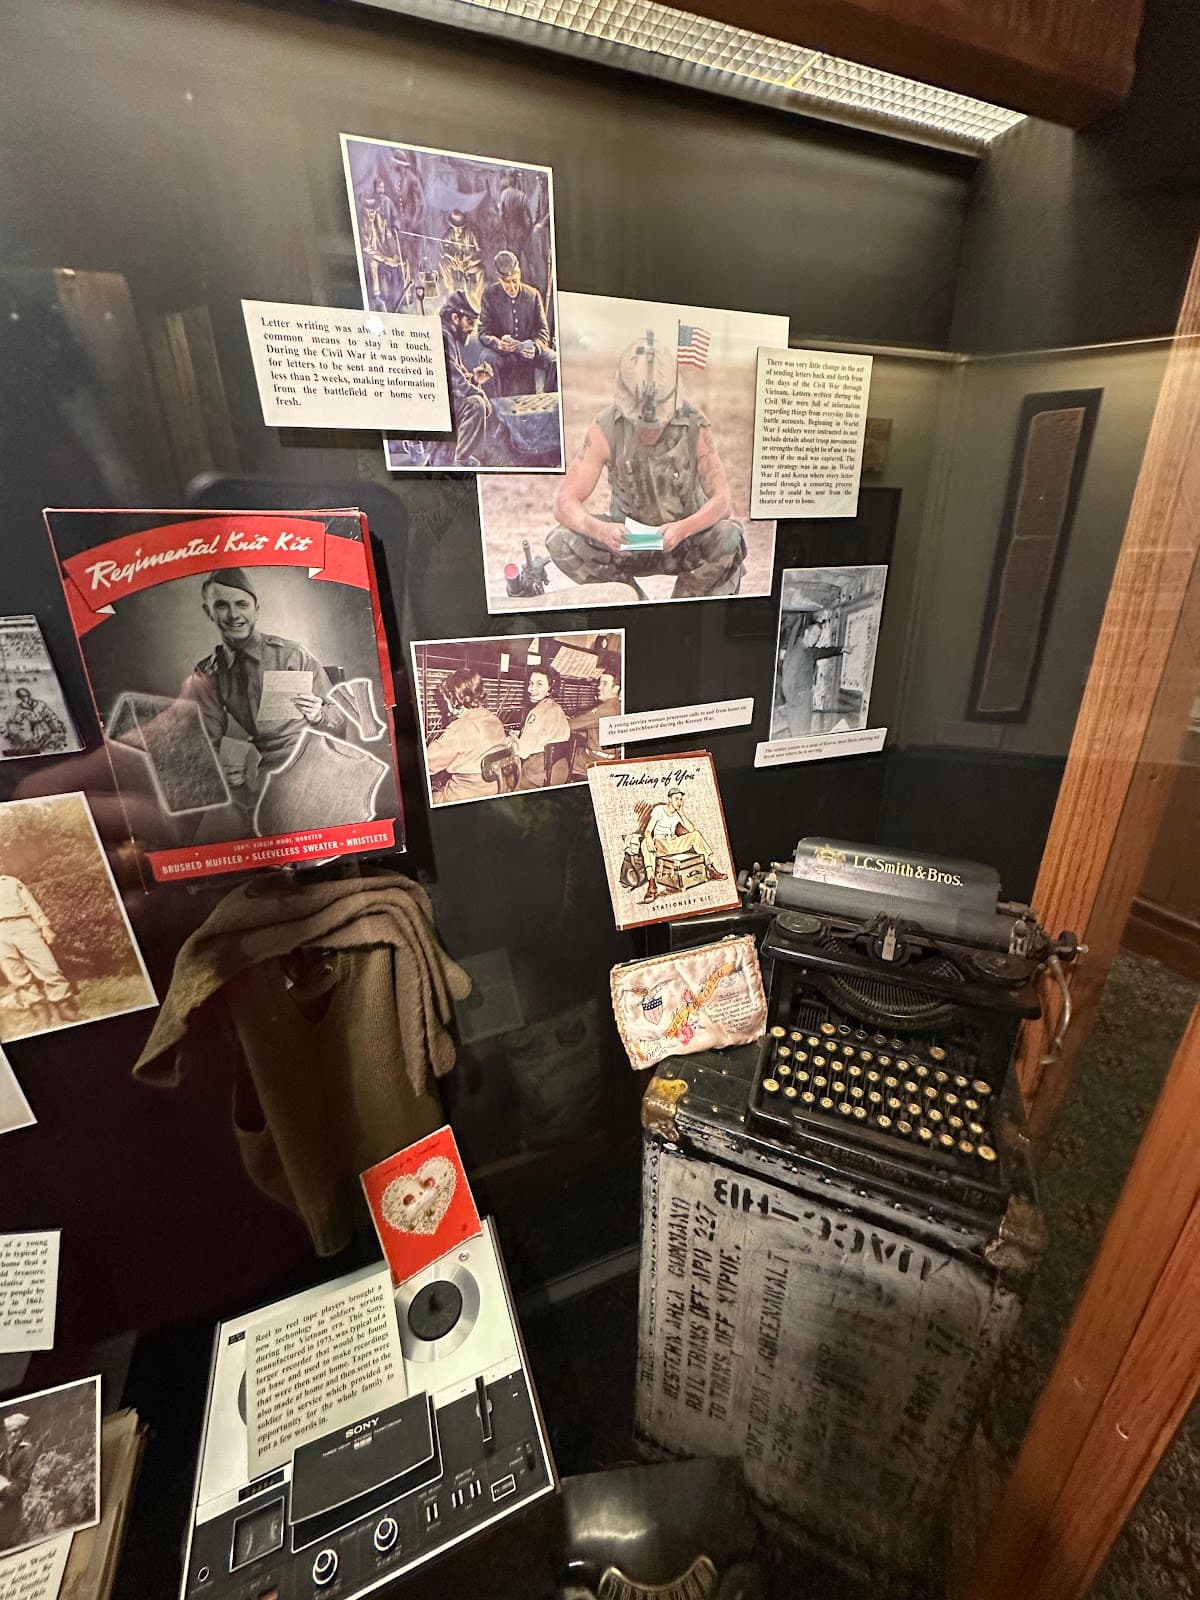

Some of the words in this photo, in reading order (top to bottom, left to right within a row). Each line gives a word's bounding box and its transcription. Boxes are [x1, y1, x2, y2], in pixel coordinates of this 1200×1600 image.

[261, 317, 290, 328] Letter
[296, 321, 330, 333] writing
[334, 324, 352, 334] was
[392, 328, 405, 337] the
[410, 331, 430, 339] most
[264, 333, 303, 342] common
[312, 337, 340, 345] means
[348, 338, 357, 346] to
[365, 340, 381, 350] stay
[390, 340, 399, 349] in
[406, 342, 432, 351] touch.
[266, 344, 300, 357] During
[303, 347, 318, 356] the
[321, 348, 343, 358] Civil
[347, 350, 366, 359] War
[371, 352, 377, 360] it
[400, 355, 433, 364] possible
[268, 357, 282, 367] for
[286, 359, 315, 369] letters
[319, 362, 328, 370] to
[332, 362, 343, 371] be
[368, 365, 384, 373] and
[388, 366, 422, 375] received
[426, 367, 434, 376] in
[271, 371, 288, 380] less
[290, 372, 311, 381] than
[313, 373, 319, 382] 2
[322, 374, 351, 384] weeks,
[353, 376, 385, 386] making
[387, 378, 435, 388] information
[273, 384, 296, 393] from
[303, 385, 317, 394] the
[324, 386, 367, 397] battlefield
[390, 390, 412, 399] home
[419, 393, 436, 402] very
[276, 396, 302, 407] fresh.
[85, 534, 219, 591] Regimental
[223, 532, 270, 553] Knit
[273, 532, 313, 552] Kit
[660, 771, 671, 787] of
[161, 861, 202, 875] BRUSHED
[205, 854, 243, 869] MUFFLER
[252, 845, 300, 861] SLEEVELESS
[302, 840, 338, 855] SWEATER
[346, 832, 388, 847] WRISTLETS
[275, 837, 293, 846] WOOL
[667, 1197, 692, 1279] COMMAND
[691, 1247, 713, 1285] APO
[256, 1330, 271, 1343] Reel
[286, 1318, 299, 1330] reel
[303, 1312, 318, 1323] tape
[321, 1301, 345, 1317] players
[349, 1288, 374, 1303] brought
[665, 1289, 685, 1330] AREA
[688, 1284, 711, 1320] OFF
[256, 1344, 269, 1353] new
[276, 1326, 312, 1345] technology
[330, 1307, 355, 1321] soldiers
[360, 1294, 384, 1308] serving
[256, 1349, 280, 1364] during
[284, 1342, 295, 1352] the
[299, 1328, 328, 1344] Vietnam
[349, 1312, 363, 1323] This
[714, 1311, 736, 1348] OFF
[256, 1346, 306, 1374] manufactured
[307, 1344, 314, 1352] in
[336, 1330, 349, 1339] was
[350, 1317, 372, 1334] typical
[373, 1313, 380, 1322] of
[257, 1370, 279, 1386] larger
[282, 1355, 312, 1374] recorder
[316, 1347, 330, 1359] that
[333, 1336, 354, 1350] would
[357, 1332, 365, 1340] be
[368, 1321, 387, 1335] found
[687, 1320, 710, 1370] TRANS
[256, 1387, 266, 1396] on
[269, 1379, 285, 1391] base
[288, 1370, 302, 1382] and
[304, 1361, 320, 1375] used
[333, 1349, 351, 1361] make
[354, 1333, 389, 1352] recordings
[257, 1395, 272, 1407] that
[275, 1387, 292, 1399] were
[294, 1378, 310, 1390] then
[312, 1370, 327, 1381] sent
[352, 1351, 372, 1364] Tapes
[374, 1343, 389, 1353] were
[709, 1352, 732, 1401] TRANS
[257, 1408, 272, 1419] also
[274, 1397, 294, 1411] made
[295, 1392, 303, 1401] at
[304, 1384, 324, 1397] home
[325, 1375, 339, 1387] and
[340, 1369, 356, 1380] then
[357, 1360, 371, 1372] sent
[381, 1353, 391, 1361] the
[258, 1414, 282, 1430] soldier
[287, 1409, 294, 1417] in
[298, 1396, 322, 1411] service
[326, 1383, 347, 1397] which
[351, 1366, 381, 1388] provided
[384, 1363, 393, 1371] an
[684, 1376, 706, 1413] RAIL
[258, 1418, 301, 1443] opportunity
[307, 1409, 317, 1419] for
[321, 1402, 333, 1412] the
[337, 1390, 357, 1404] whole
[362, 1378, 383, 1393] family
[345, 1417, 380, 1439] SONY
[708, 1401, 728, 1422] TO
[258, 1442, 271, 1457] put
[273, 1440, 278, 1448] a
[280, 1433, 292, 1445] few
[294, 1420, 317, 1437] words
